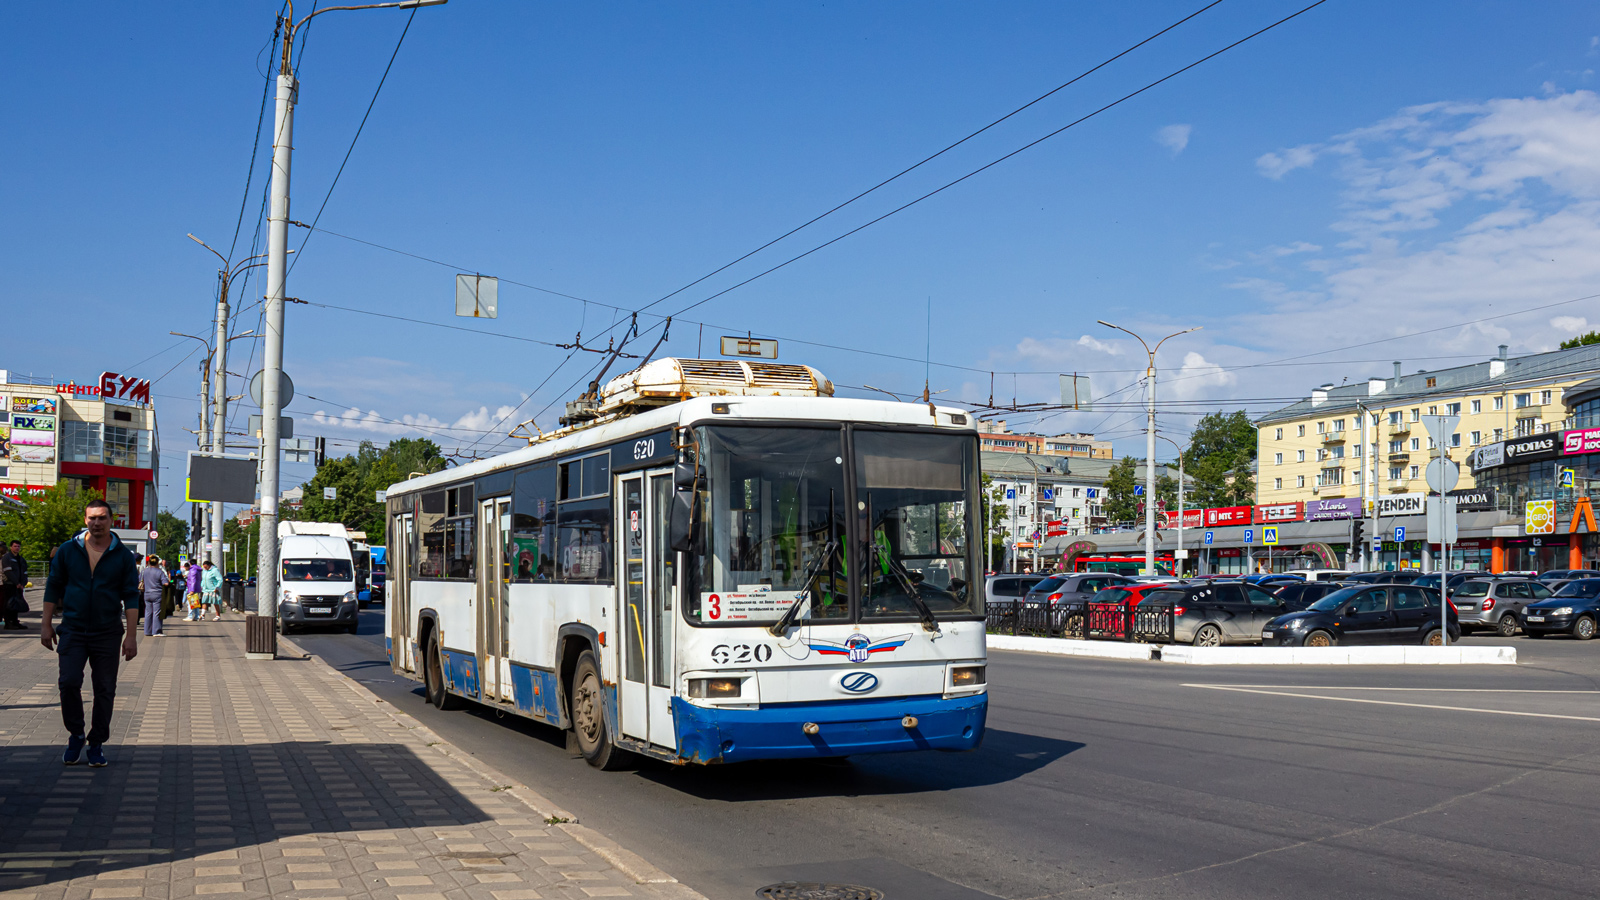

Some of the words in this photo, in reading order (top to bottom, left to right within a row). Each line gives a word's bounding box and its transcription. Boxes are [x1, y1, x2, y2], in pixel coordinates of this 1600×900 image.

[56, 383, 101, 396] ЦЕНТР
[99, 371, 150, 404] БУМ
[14, 398, 38, 406] БОЕЦ
[14, 416, 36, 428] FIX
[634, 438, 655, 460] 620
[1515, 439, 1554, 453] ТОПАЗ
[3, 487, 46, 496] МАНИТ
[1378, 498, 1420, 512] ZENDEN
[1455, 494, 1488, 505] LMODA
[1218, 512, 1232, 520] МТС
[1412, 541, 1422, 550] 24
[1533, 537, 1542, 546] t2
[708, 593, 721, 619] 3
[711, 644, 772, 664] 620
[849, 648, 868, 661] АТП
